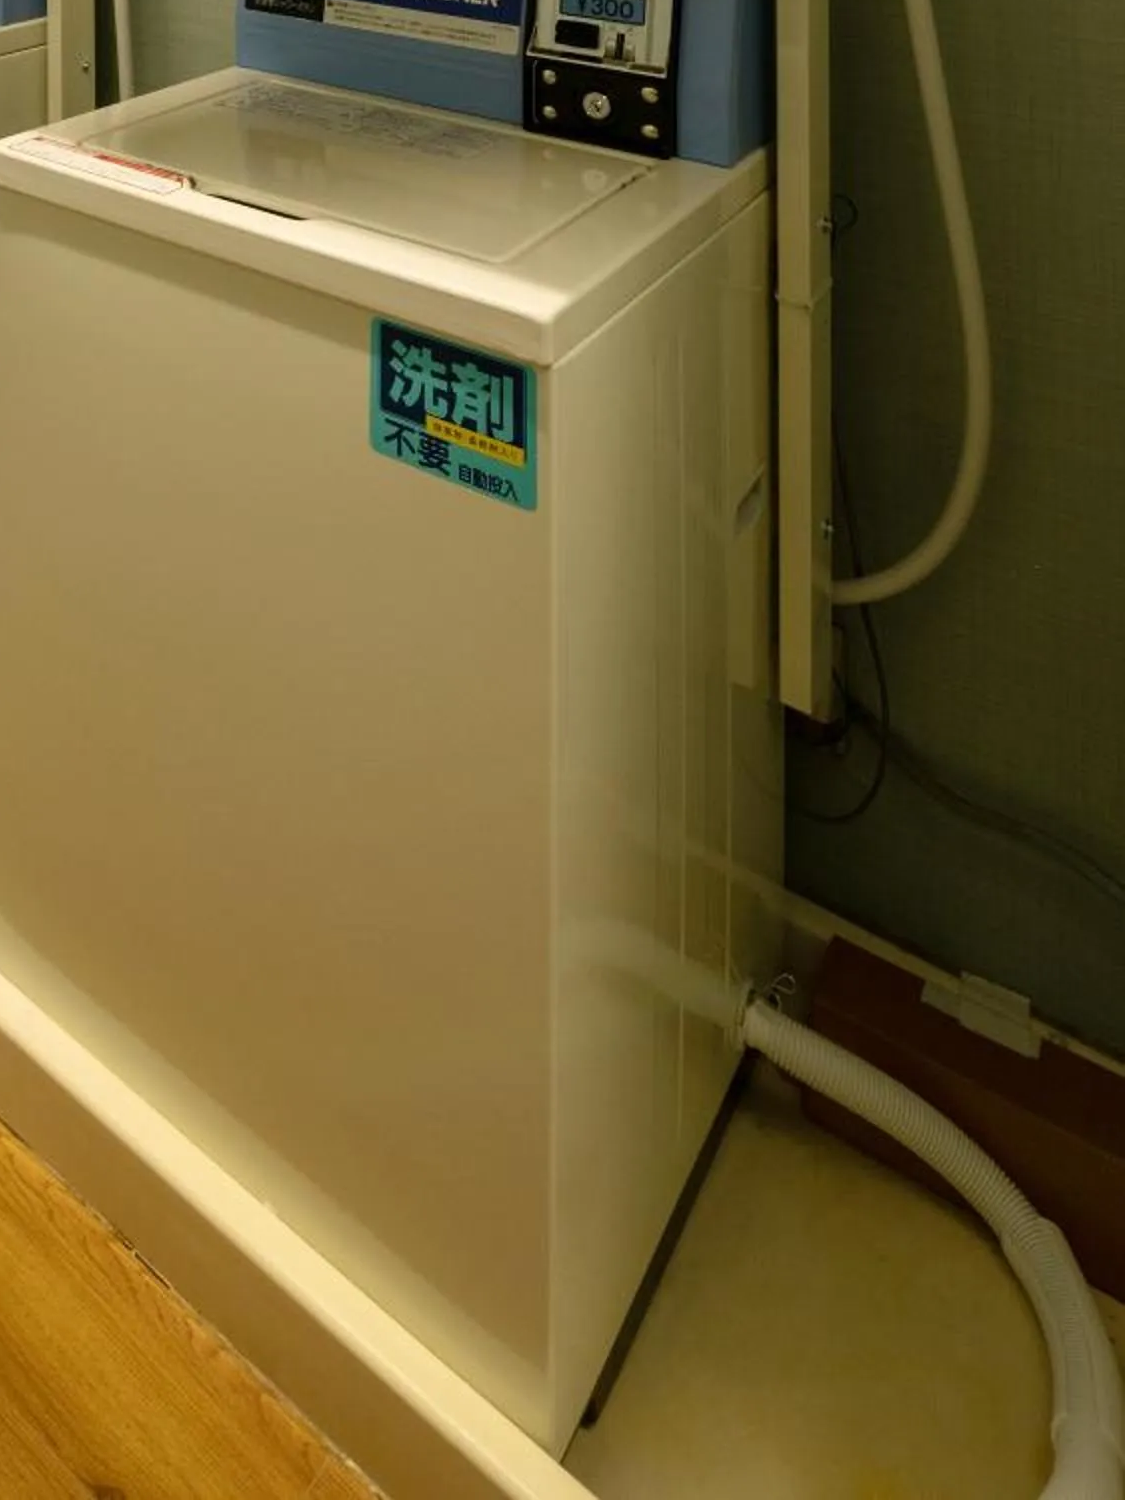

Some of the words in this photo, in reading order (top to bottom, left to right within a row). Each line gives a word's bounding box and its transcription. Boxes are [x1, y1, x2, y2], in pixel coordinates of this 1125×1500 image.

[389, 340, 514, 443] 洗剤
[384, 417, 451, 477] 不要
[458, 464, 519, 502] 自動投入
